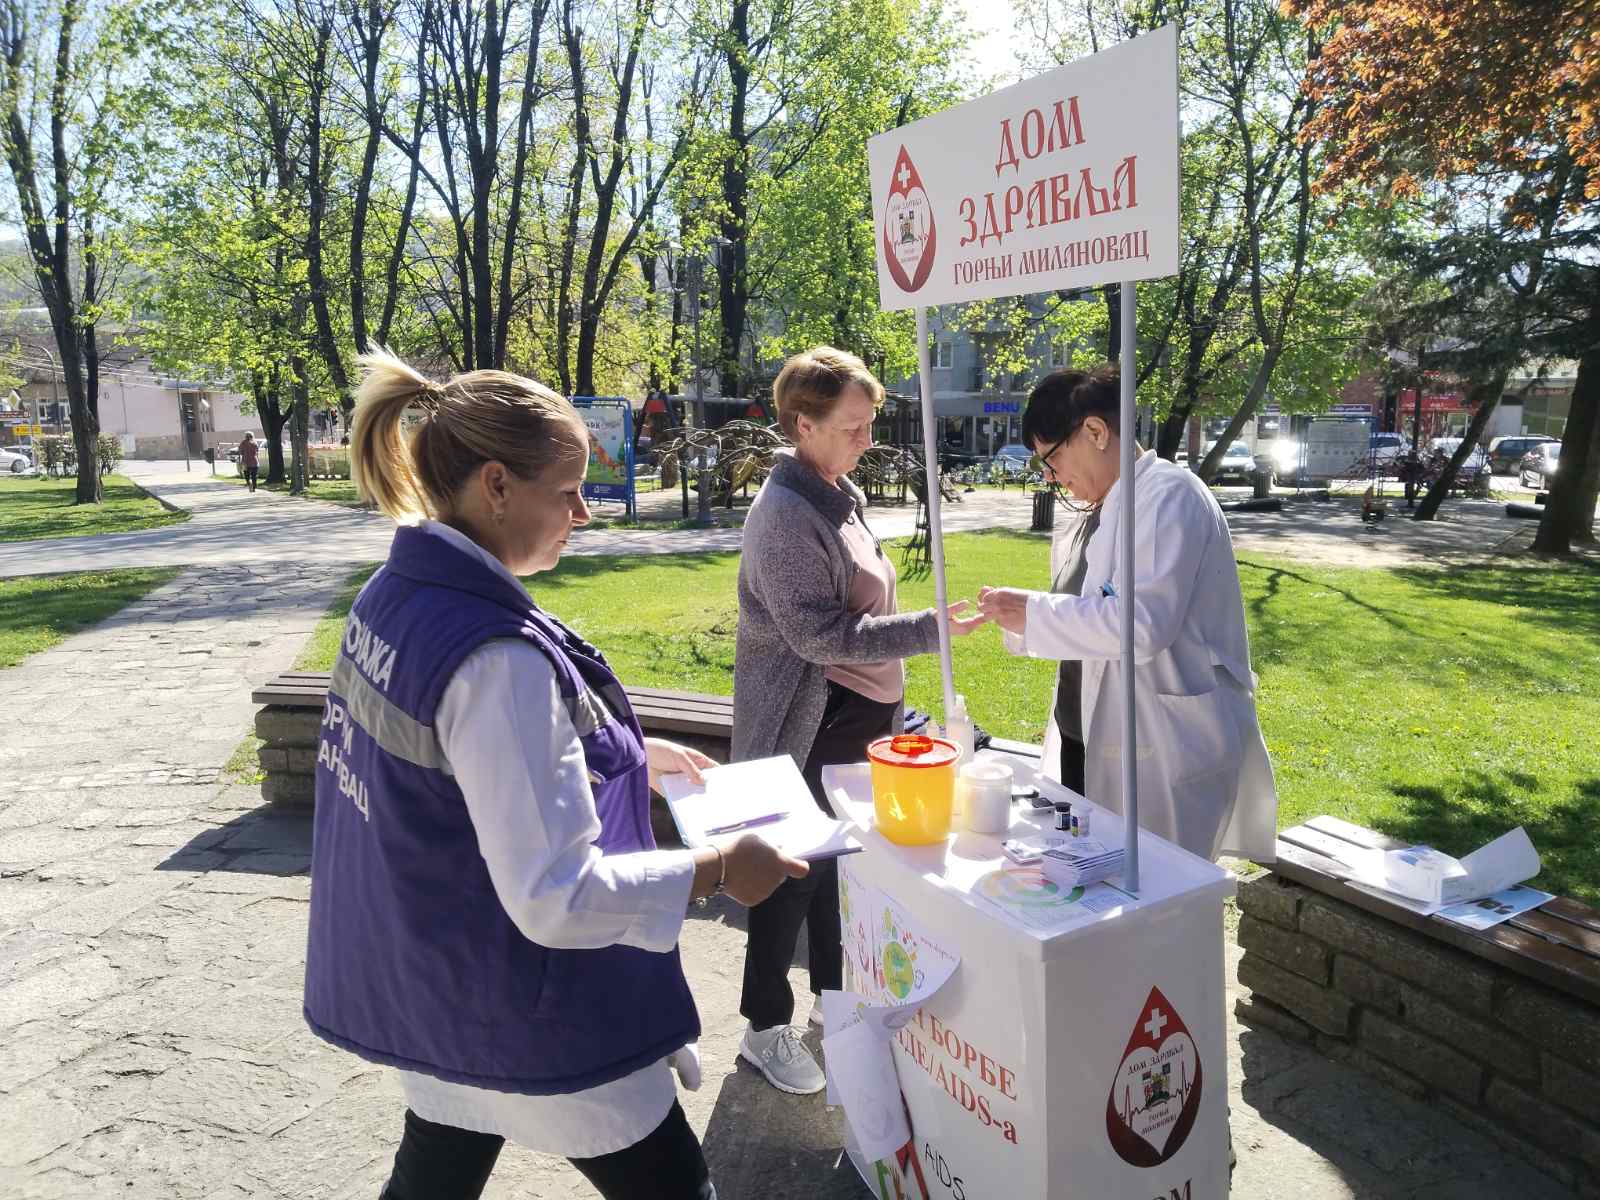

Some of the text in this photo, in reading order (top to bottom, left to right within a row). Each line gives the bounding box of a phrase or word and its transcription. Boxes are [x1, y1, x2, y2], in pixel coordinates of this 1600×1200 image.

[995, 95, 1086, 177] ДОМ
[959, 155, 1139, 248] ЗДРАВЉА
[954, 230, 1151, 285] ГОРЊИ МИЛАНОВАЦ
[984, 401, 1020, 413] BENU
[928, 1012, 1018, 1101] БОРБЕ
[925, 1143, 966, 1200] AIDS
